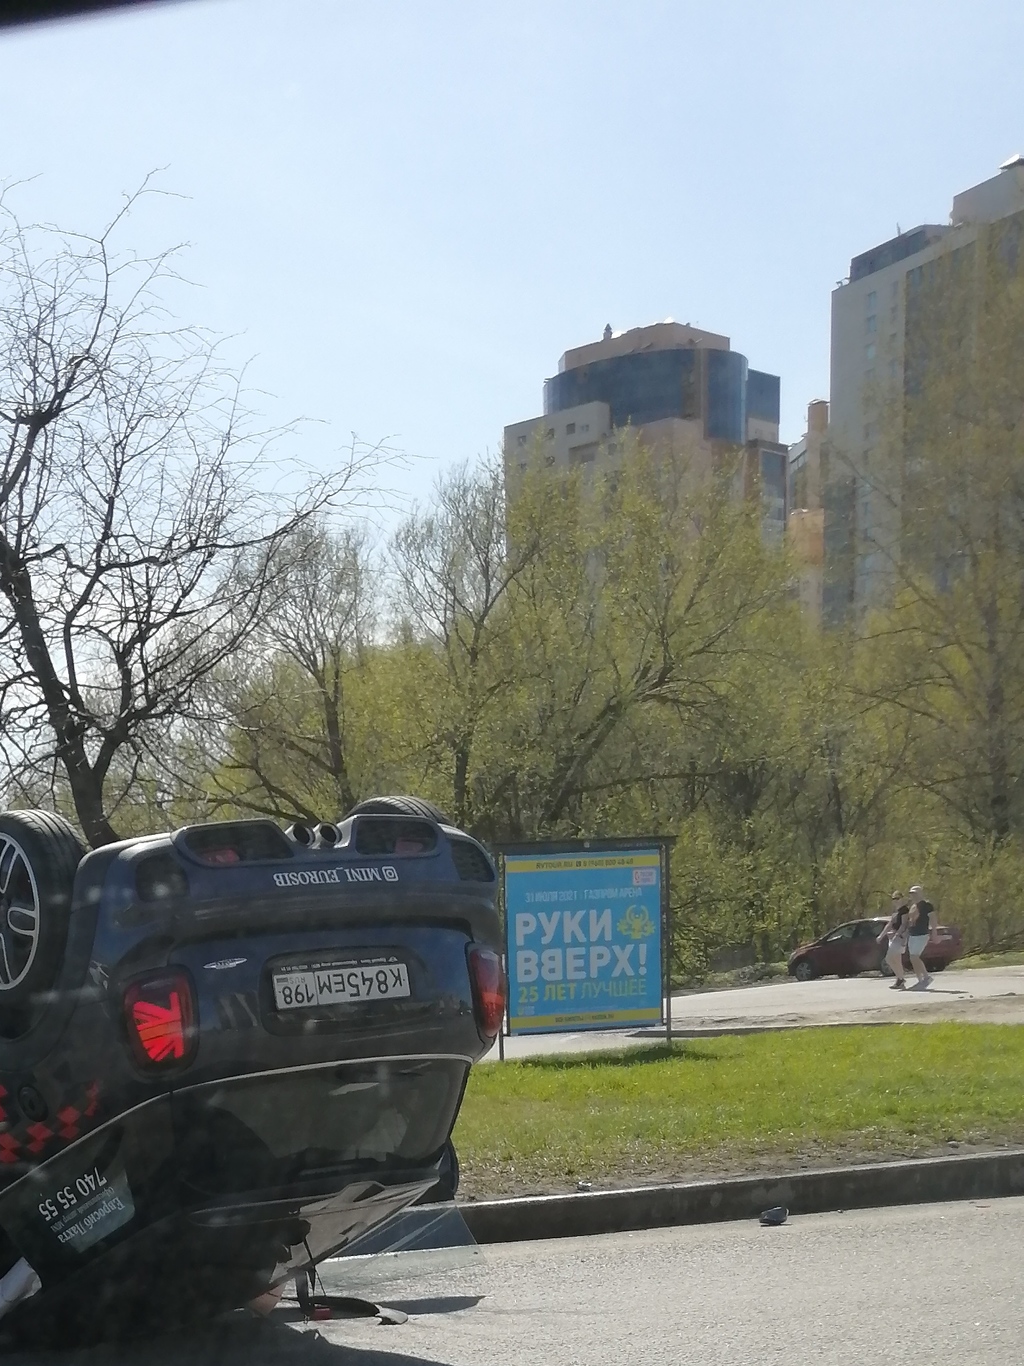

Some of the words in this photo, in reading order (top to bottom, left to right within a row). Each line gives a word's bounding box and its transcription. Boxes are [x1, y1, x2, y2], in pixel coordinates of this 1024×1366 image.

[273, 867, 382, 887] MINI_EUROSIB
[515, 909, 612, 946] РУКИ
[518, 986, 539, 1003] 25
[543, 982, 576, 1001] ЛЕТ
[580, 979, 647, 999] ЛУЧШЕЕ
[76, 1166, 107, 1196] 740
[38, 1199, 58, 1221] 55
[57, 1186, 77, 1210] 55
[83, 1197, 126, 1230] Евросиб
[57, 1220, 87, 1243] Лахта
